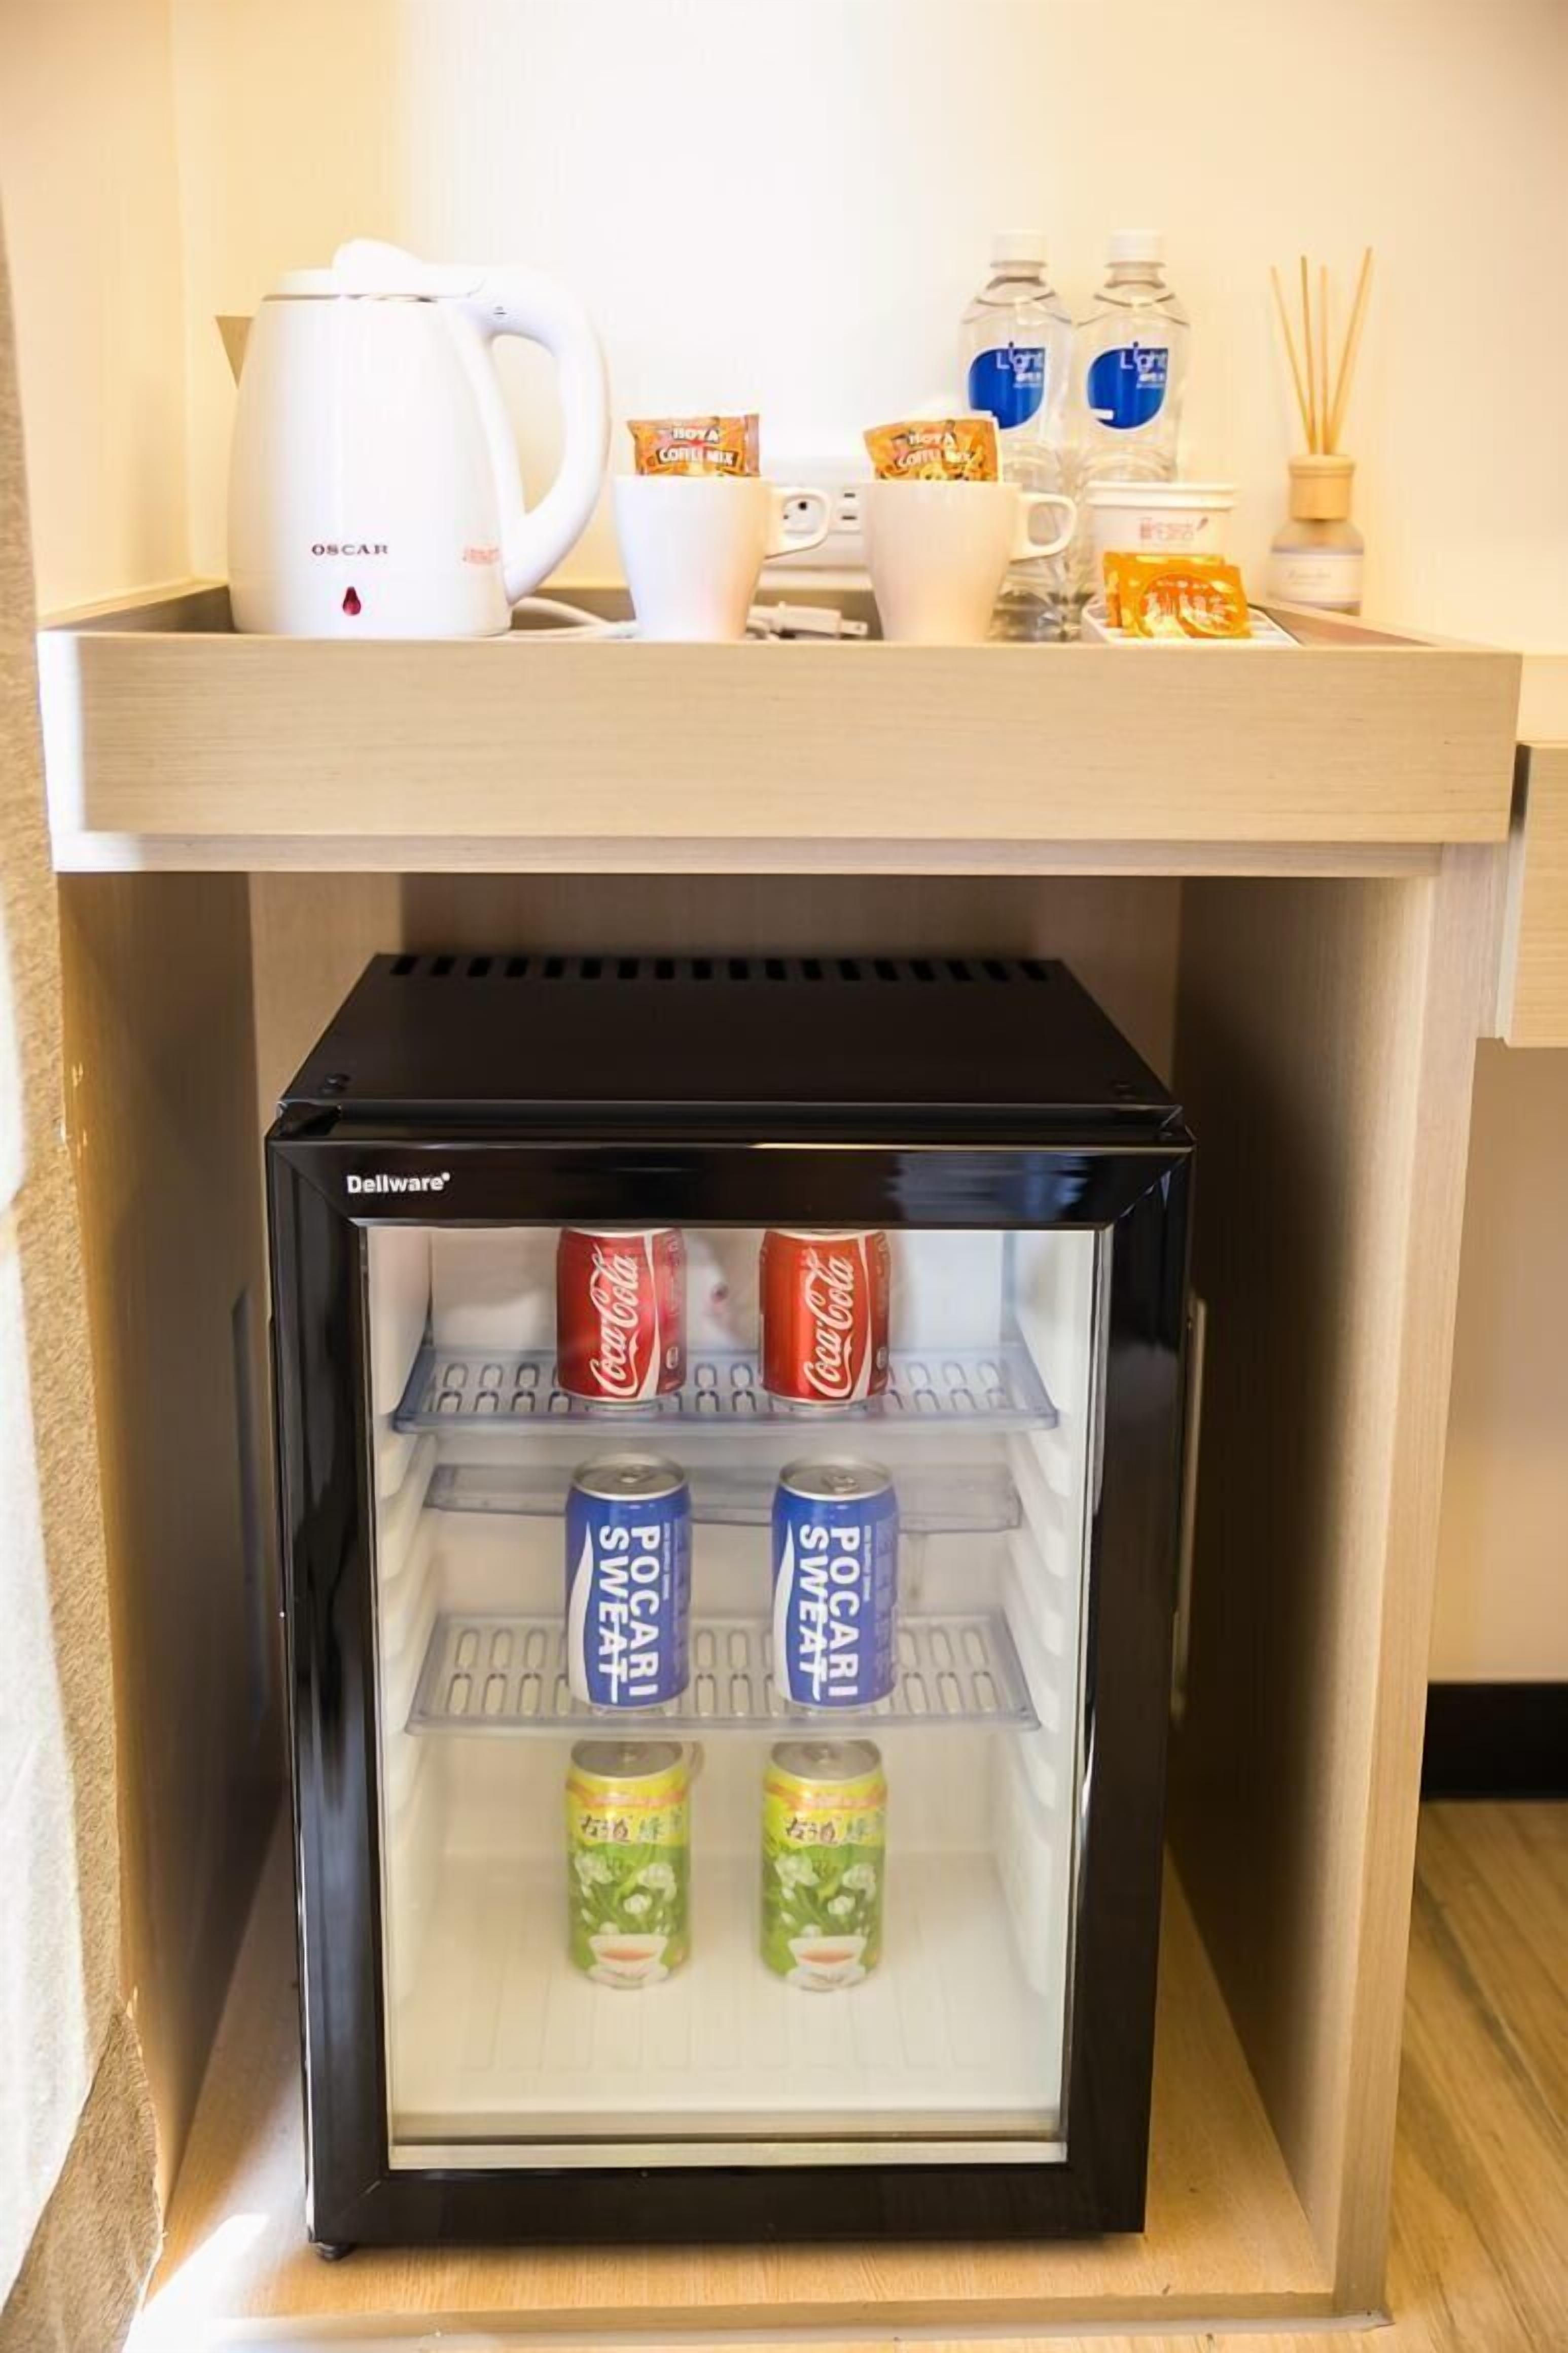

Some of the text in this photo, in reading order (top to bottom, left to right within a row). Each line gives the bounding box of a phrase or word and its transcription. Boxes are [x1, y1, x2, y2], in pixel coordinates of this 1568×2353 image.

[311, 544, 388, 556] OSCAR
[346, 1173, 444, 1193] Dellware
[598, 1525, 630, 1684] SWEAT
[629, 1524, 660, 1697] POCARI
[799, 1525, 830, 1683] SWEAT
[828, 1525, 861, 1697] POCARI
